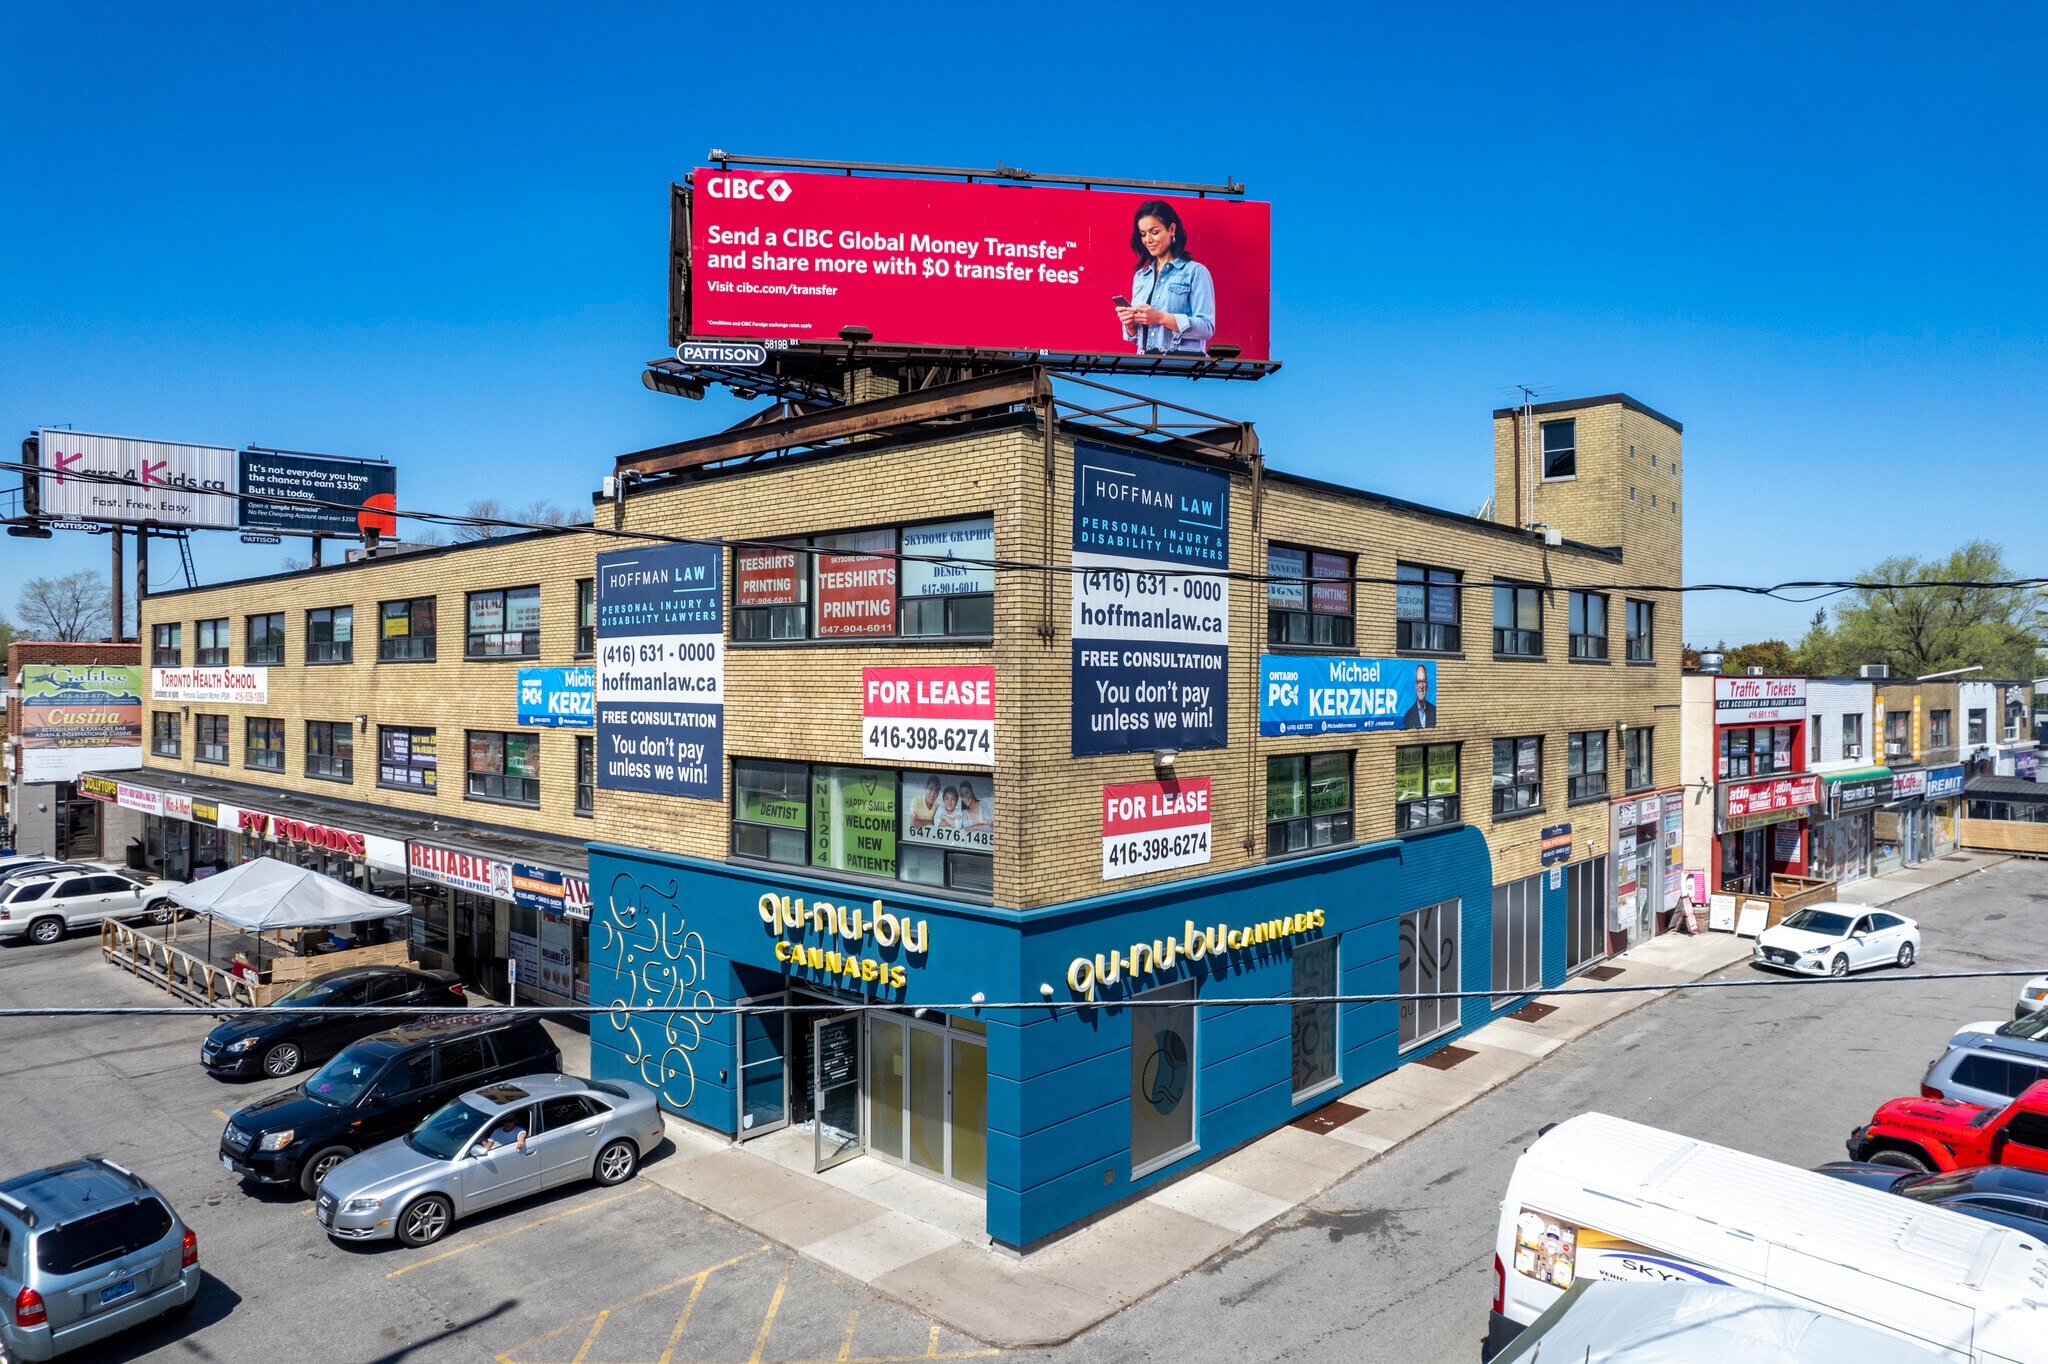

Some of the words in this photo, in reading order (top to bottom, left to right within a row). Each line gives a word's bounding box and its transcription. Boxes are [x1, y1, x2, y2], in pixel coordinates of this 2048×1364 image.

[707, 177, 765, 200] CIBC
[708, 225, 759, 246] Send
[765, 231, 777, 246] a
[782, 228, 833, 249] CIBC
[838, 231, 904, 251] Global
[910, 233, 979, 258] Money
[707, 250, 746, 270] and
[751, 251, 809, 272] share
[814, 257, 867, 274] more
[872, 256, 916, 276] with
[922, 257, 950, 278] $0
[954, 260, 1034, 281] transfer
[707, 280, 734, 292] Visit
[736, 282, 838, 296] cibc.com/transfer
[684, 347, 759, 361] PATTISON
[764, 339, 788, 350] 5819B
[248, 463, 266, 473] It's
[268, 466, 284, 475] not
[286, 469, 327, 480] everyday
[329, 472, 345, 481] you
[347, 473, 368, 483] have
[248, 473, 265, 482] the
[266, 474, 300, 485] chance
[302, 478, 312, 487] to
[314, 480, 335, 489] earn
[248, 486, 265, 495] But
[267, 487, 275, 495] it
[277, 488, 285, 496] is
[286, 489, 315, 500] today.
[1096, 480, 1174, 509] HOFFMAN
[1181, 496, 1213, 516] LAW
[92, 496, 121, 508] Fast.
[126, 499, 156, 511] Free.
[160, 501, 192, 515] Easy.
[53, 521, 97, 531] PATTISON
[1082, 516, 1156, 537] PERSONAL
[1163, 528, 1209, 545] INJURY
[1216, 537, 1222, 548] &
[243, 536, 279, 544] PATTISON
[904, 531, 948, 546] SKYDOME
[1081, 531, 1162, 552] DISABILITY
[1169, 543, 1223, 561] LAWYERS
[740, 554, 795, 571] TEESHIRTS
[933, 565, 968, 578] DESIGN
[610, 569, 668, 589] HOFFMAN
[675, 565, 705, 582] LAW
[743, 577, 791, 593] PRINTING
[819, 568, 896, 590] TEESHIRTS
[1082, 570, 1131, 599] (416)
[1136, 574, 1166, 596] 631
[1183, 578, 1221, 602] 0000
[1312, 587, 1347, 601] PRINTING
[602, 602, 654, 615] PERSONAL
[660, 598, 702, 611] INJURY
[709, 598, 716, 608] &
[823, 598, 891, 619] PRINTING
[601, 613, 659, 627] DISABILITY
[665, 610, 717, 622] LAWYERS
[1081, 602, 1222, 633] hoffmanlaw.ca
[820, 623, 892, 634] 647-904-6011
[603, 645, 635, 668] (416)
[639, 644, 664, 662] 631
[678, 642, 715, 662] 0000
[1081, 650, 1119, 667] FREE
[1122, 651, 1222, 670] CONSULTATION
[49, 668, 127, 684] Galilee
[160, 669, 191, 688] TORONTO
[192, 669, 222, 689] HEALTH
[224, 668, 257, 689] SCHOOL
[602, 671, 717, 692] hoffmanlaw.ca
[1269, 671, 1299, 681] ONTARIO
[1329, 660, 1381, 683] Michael
[868, 680, 911, 704] FOR
[917, 680, 990, 705] LEASE
[1096, 680, 1130, 704] You
[1182, 685, 1210, 708] pay
[1268, 683, 1292, 707] PC
[1730, 681, 1760, 698] Traffic
[1766, 680, 1797, 697] Tickets
[1309, 688, 1398, 717] KERZNER
[1719, 700, 1730, 709] CAR
[1730, 700, 1759, 708] ACCIDENTS
[1759, 699, 1770, 707] AND
[1770, 699, 1787, 707] INJURY
[47, 708, 120, 725] Cusina
[602, 710, 628, 724] FREE
[630, 711, 717, 728] CONSULTATION
[1091, 707, 1149, 732] unless
[1154, 710, 1177, 729] we
[1181, 706, 1213, 728] win!
[869, 725, 990, 753] 416-398-6274
[612, 734, 636, 755] You
[678, 742, 705, 765] pay
[609, 757, 651, 779] unless
[654, 764, 674, 780] we
[677, 763, 708, 785] win!
[760, 803, 799, 820] DENTIST
[845, 797, 867, 811] HAPPY
[1107, 796, 1147, 822] FOR
[1151, 789, 1208, 817] LEASE
[1725, 816, 1747, 831] NBI
[273, 817, 367, 857] FOODS
[857, 835, 882, 851] NEW
[1109, 831, 1207, 867] 416-398-6274
[411, 843, 491, 884] RELIABLE
[446, 876, 465, 886] CARGO
[465, 881, 490, 893] EXPRESS
[1228, 908, 1325, 950] CANNABIS
[775, 940, 907, 989] CANNABIS
